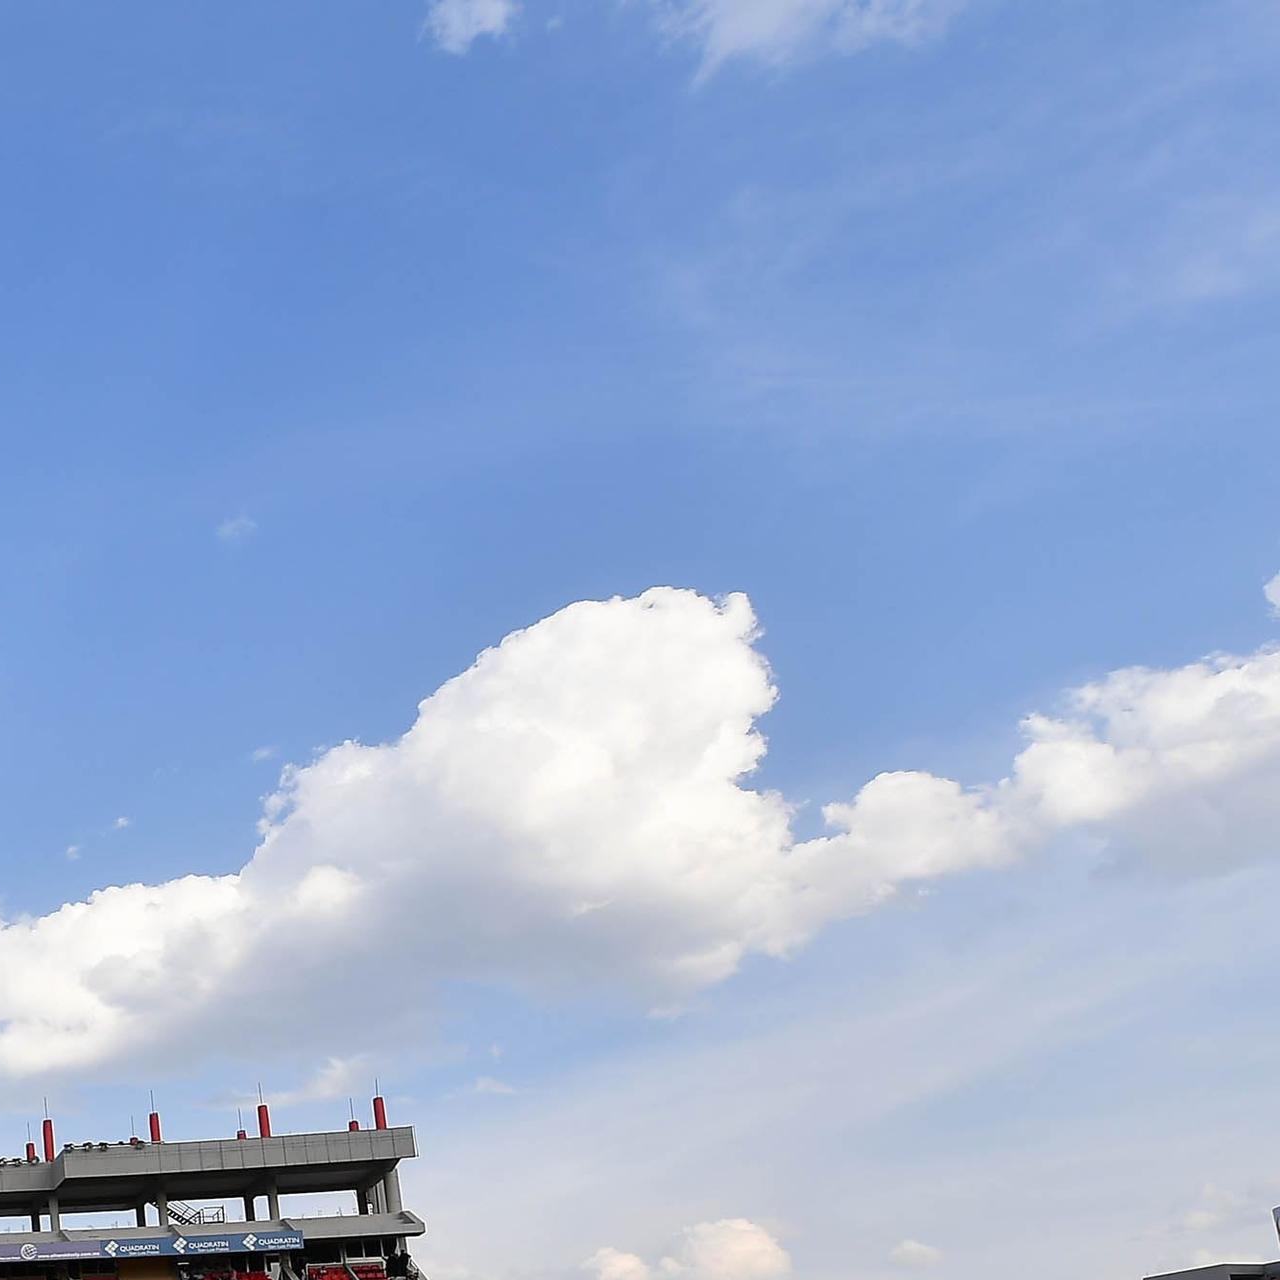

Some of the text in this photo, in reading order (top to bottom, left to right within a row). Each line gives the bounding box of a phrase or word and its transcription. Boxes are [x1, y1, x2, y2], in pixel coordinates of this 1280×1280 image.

[188, 1241, 229, 1249] QUADRATIN
[258, 1236, 300, 1246] QUADRATIN
[120, 1244, 160, 1252] QUADRATIN
